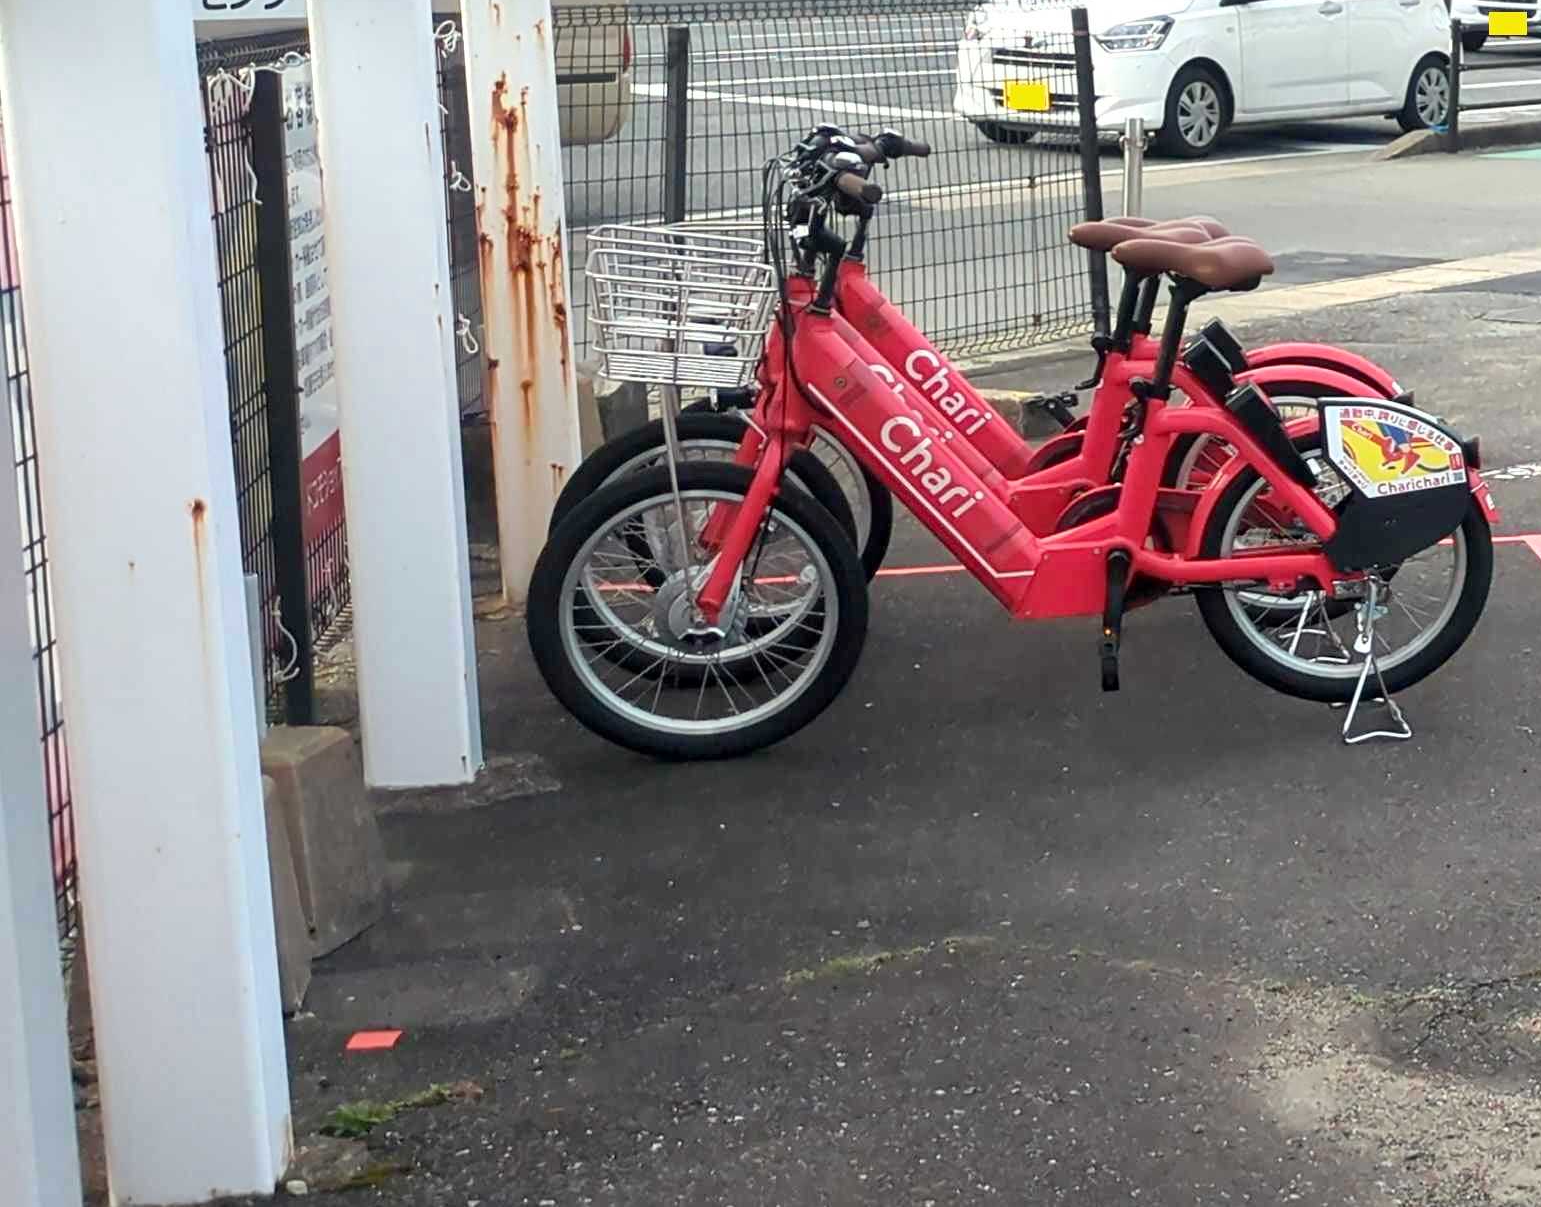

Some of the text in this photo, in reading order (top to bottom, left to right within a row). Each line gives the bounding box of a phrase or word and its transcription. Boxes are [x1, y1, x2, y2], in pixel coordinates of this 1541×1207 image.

[905, 349, 993, 436] Chari
[881, 416, 984, 519] Chari
[1377, 473, 1451, 495] Charichari
